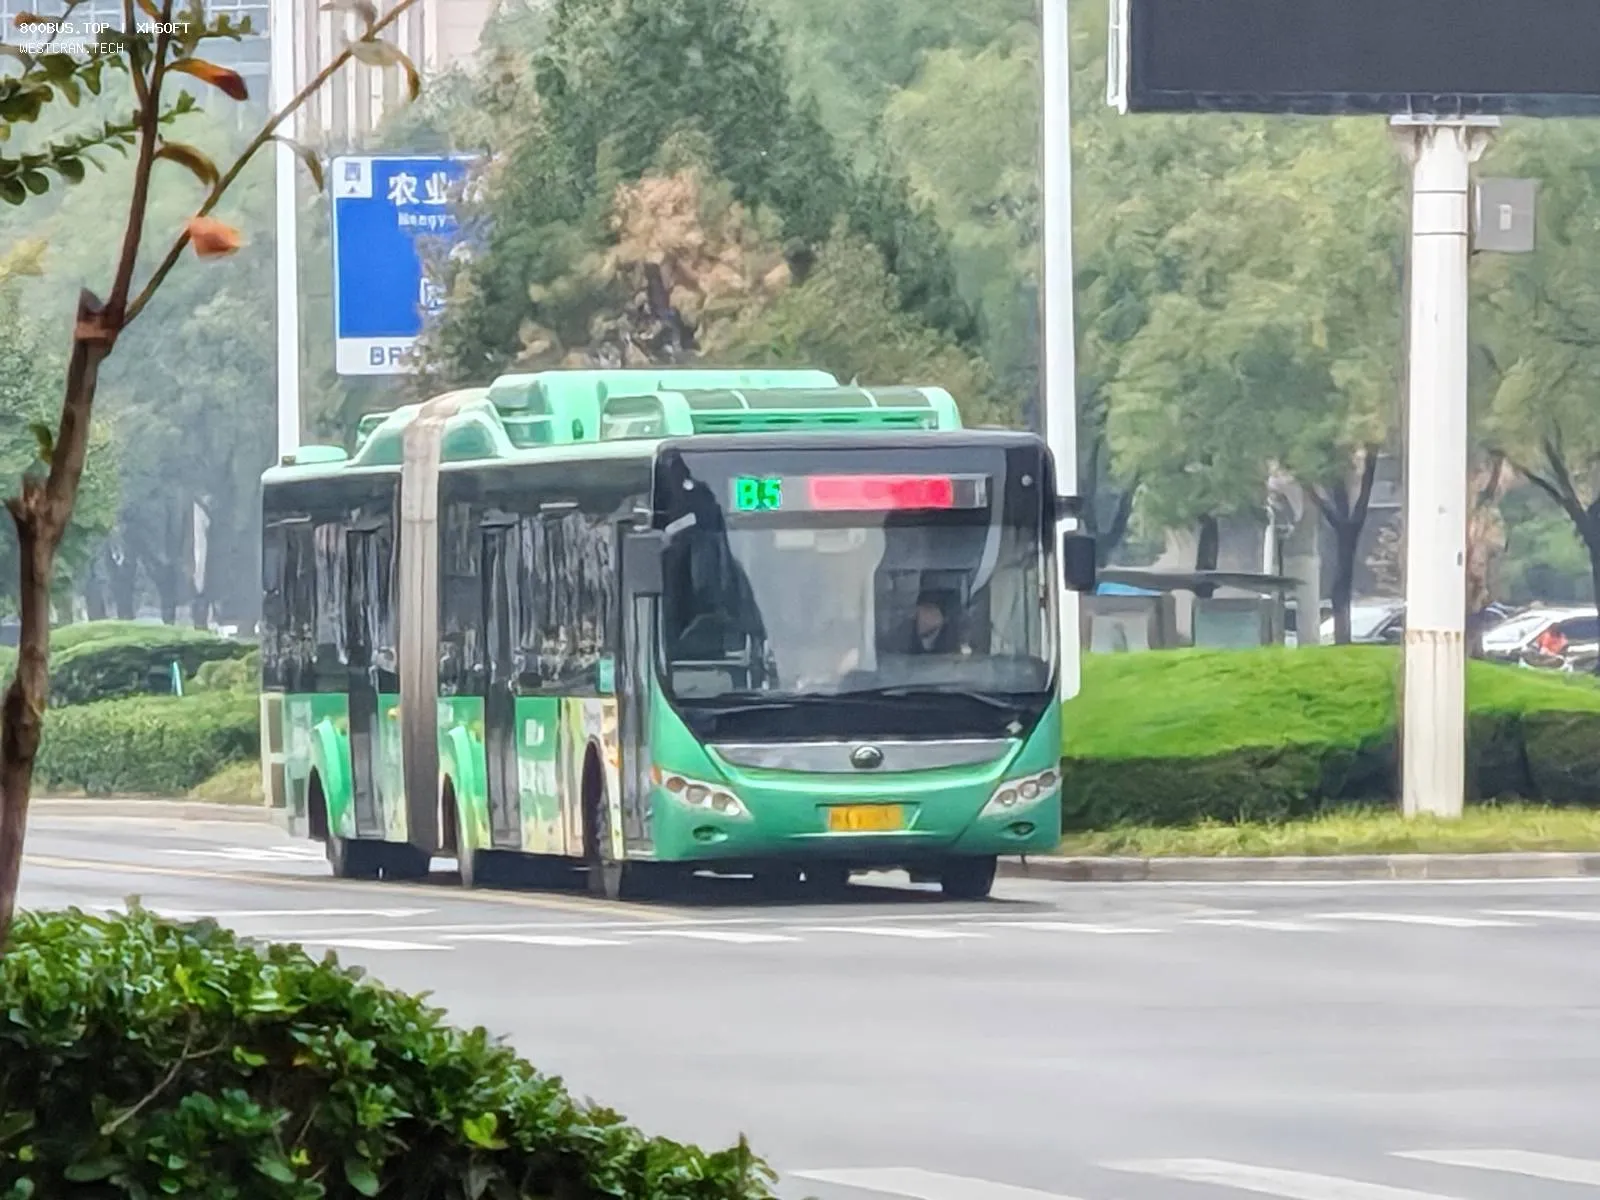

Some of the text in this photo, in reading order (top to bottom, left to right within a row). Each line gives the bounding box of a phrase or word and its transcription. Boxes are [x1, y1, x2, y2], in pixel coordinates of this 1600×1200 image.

[387, 172, 466, 206] 农业
[370, 346, 414, 366] BR
[736, 477, 781, 511] B5
